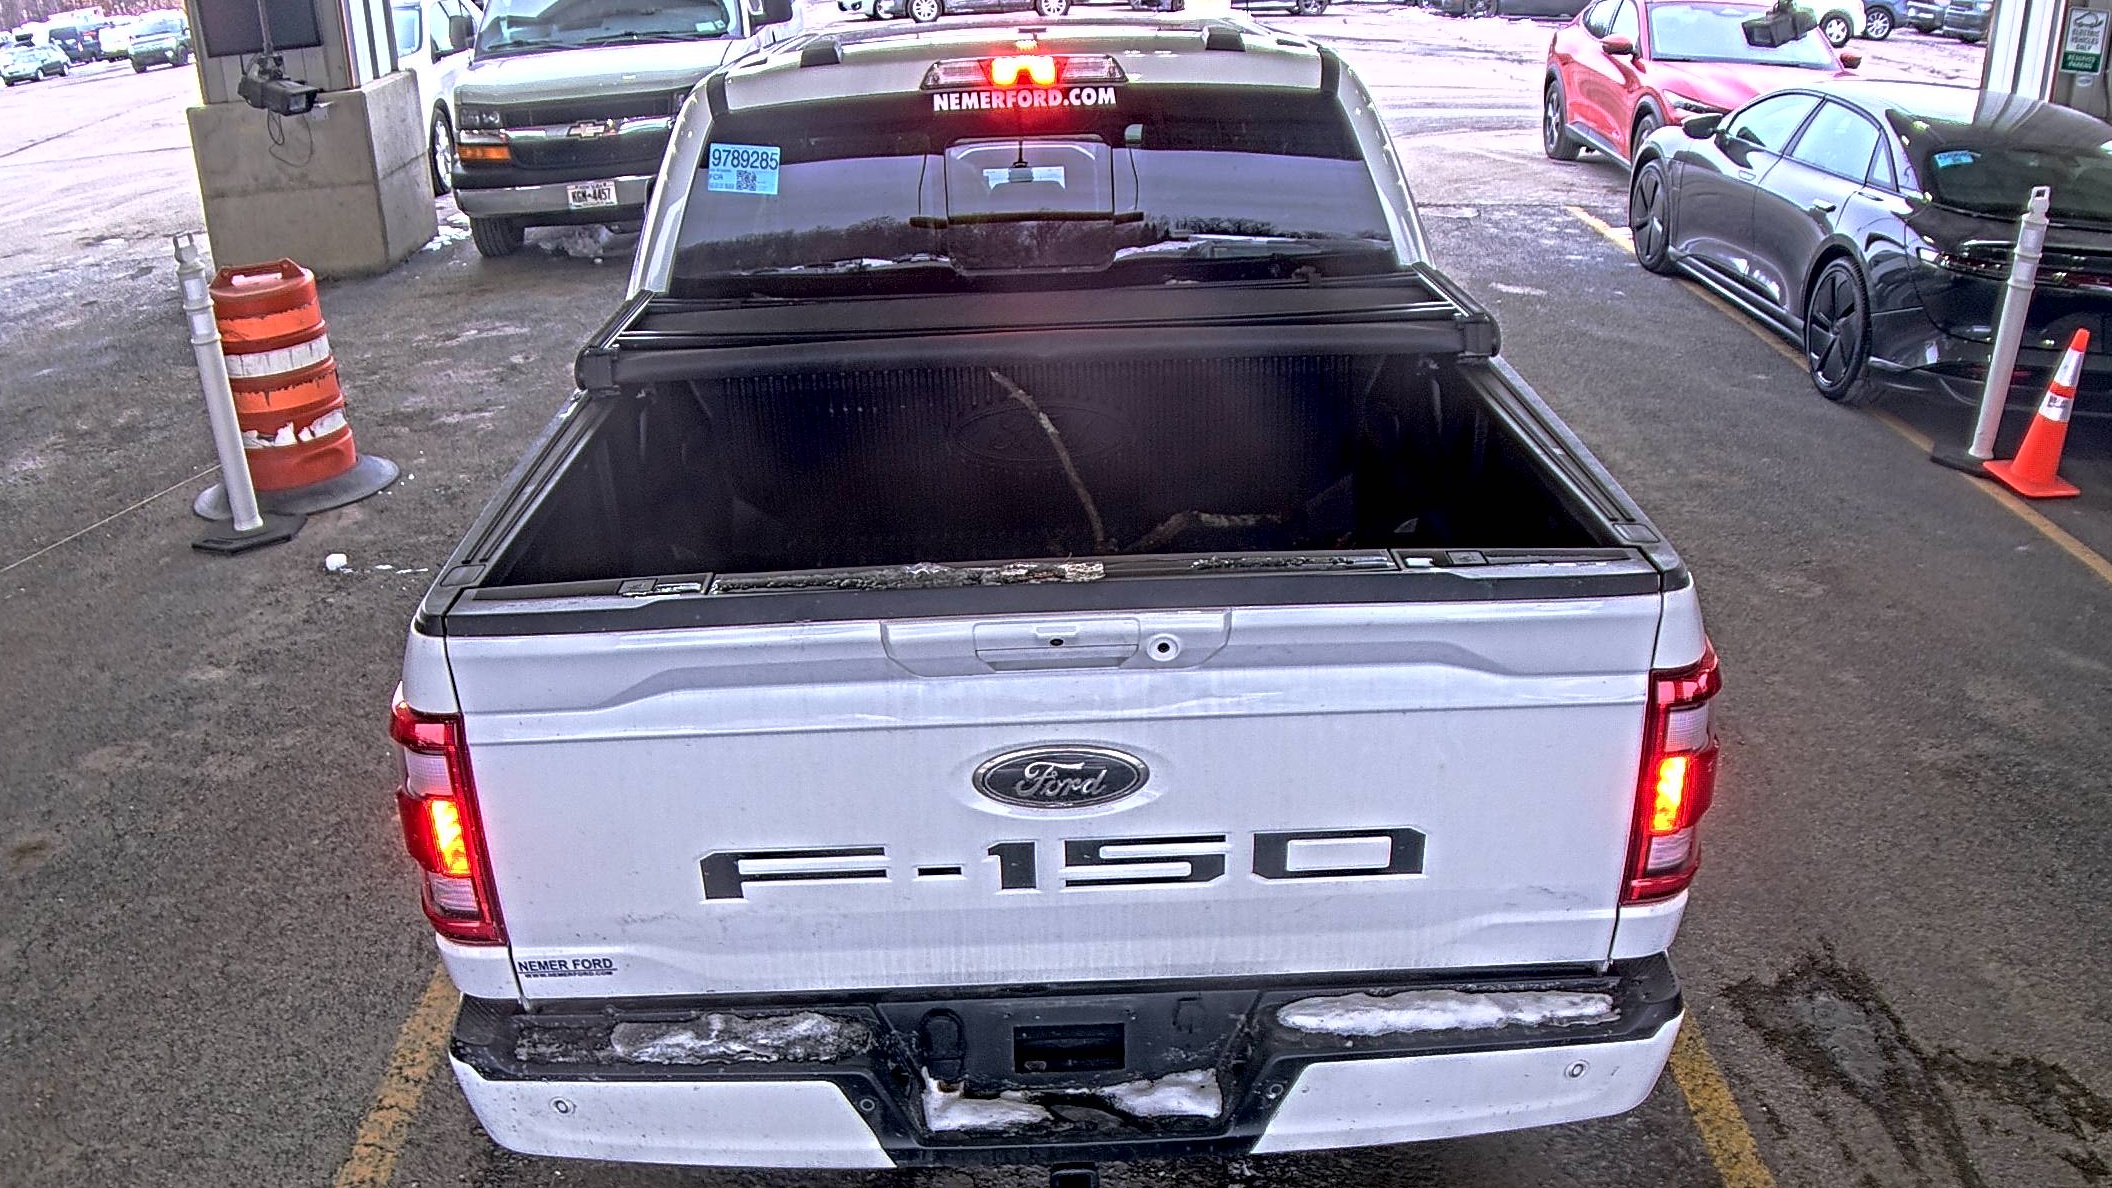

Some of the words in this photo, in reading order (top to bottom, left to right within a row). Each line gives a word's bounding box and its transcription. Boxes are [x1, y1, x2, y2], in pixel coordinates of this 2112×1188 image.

[933, 87, 1117, 111] NEMERFORD.COM
[711, 148, 779, 170] 9789285
[1015, 761, 1108, 797] Ford
[700, 827, 1427, 902] F-150
[518, 960, 569, 971] NEMER
[572, 958, 613, 970] FORD
